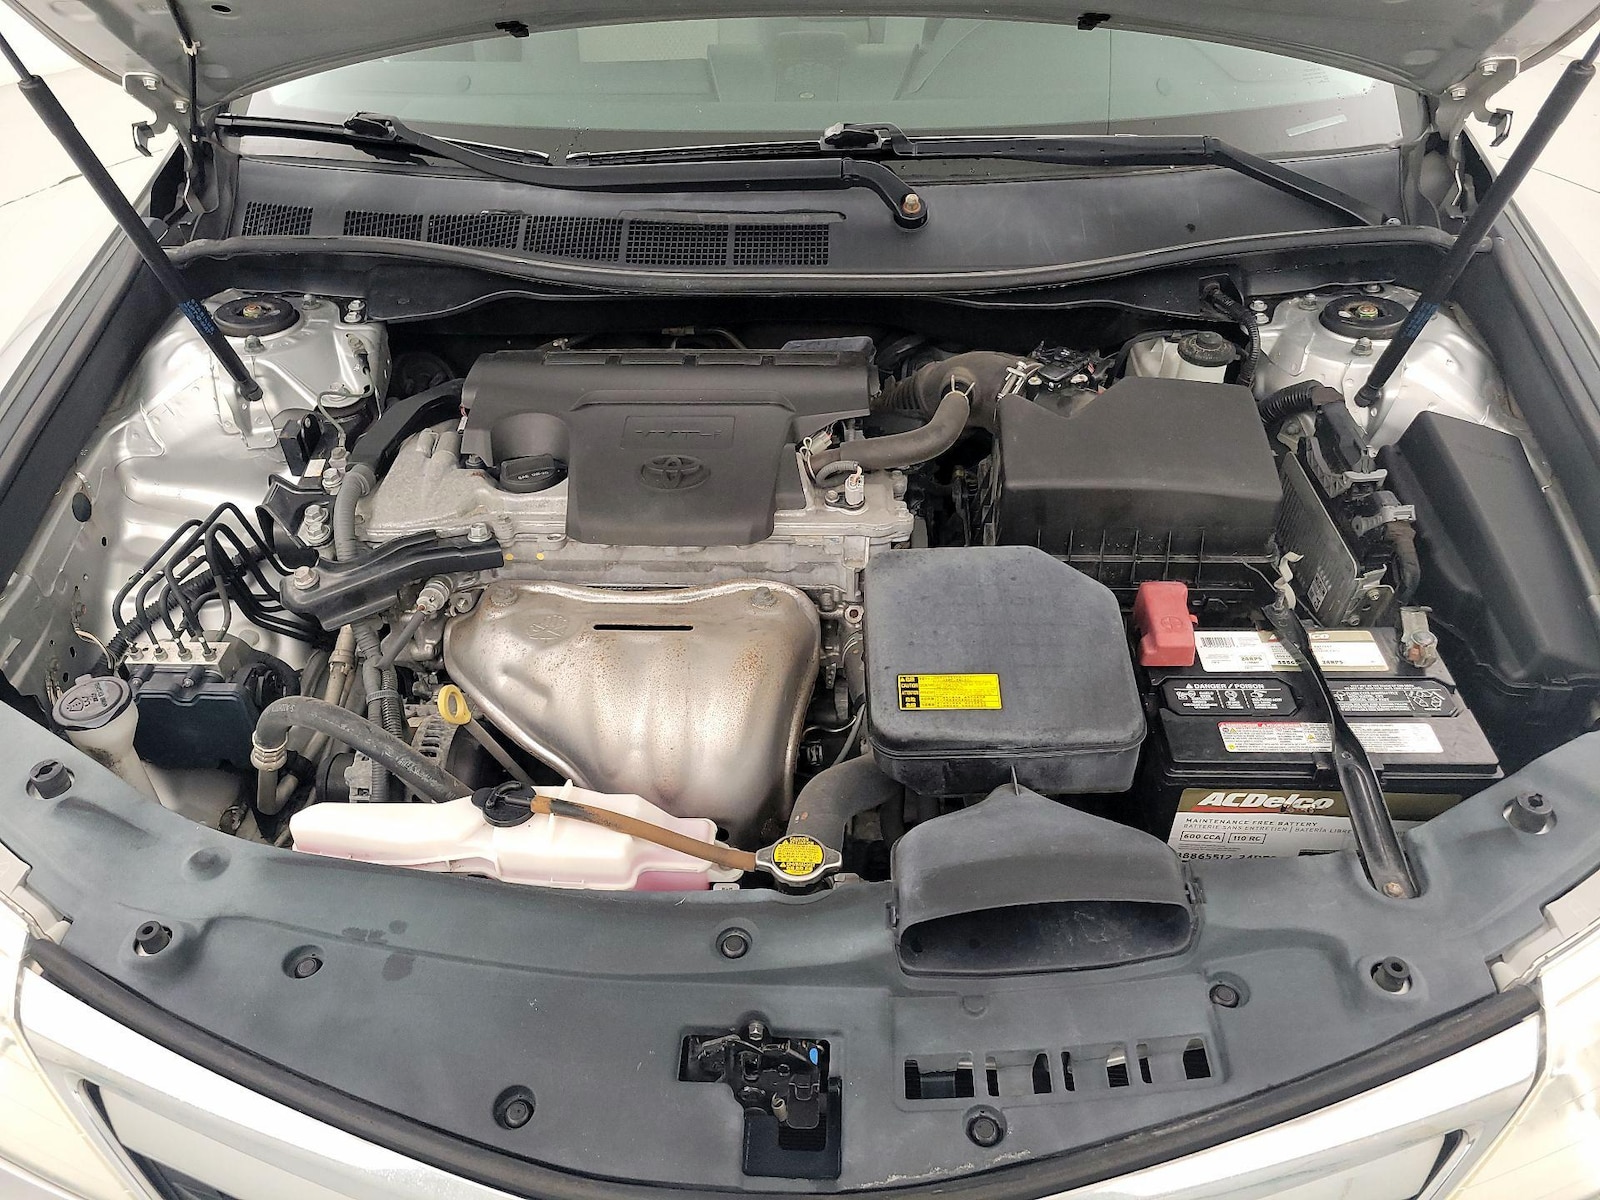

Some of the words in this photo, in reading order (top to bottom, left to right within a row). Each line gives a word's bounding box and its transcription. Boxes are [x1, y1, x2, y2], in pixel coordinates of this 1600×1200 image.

[191, 298, 214, 332] STABILUS
[1197, 792, 1334, 810] ACDelco
[1185, 817, 1249, 825] MAINTENANCE
